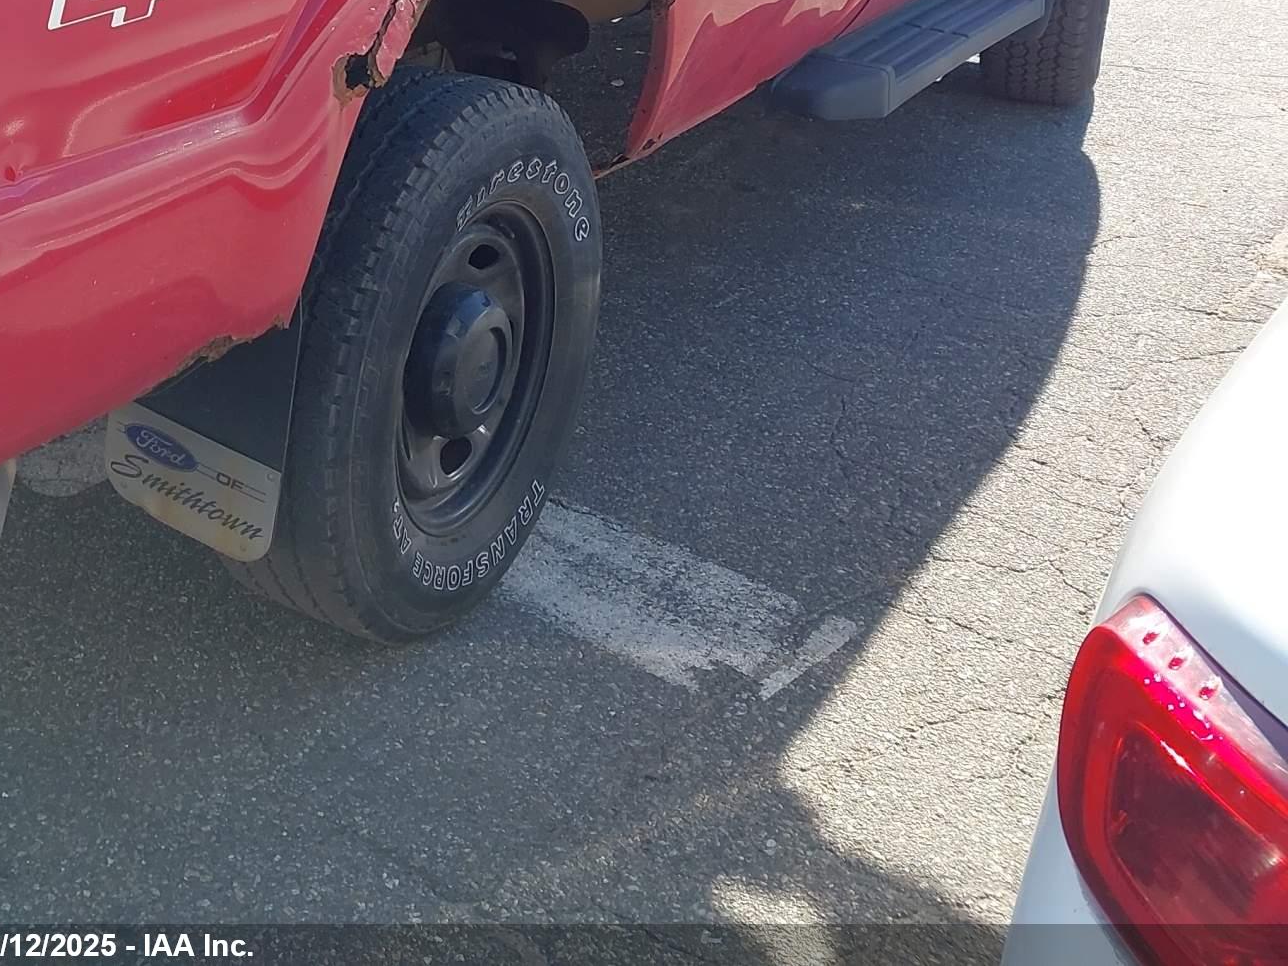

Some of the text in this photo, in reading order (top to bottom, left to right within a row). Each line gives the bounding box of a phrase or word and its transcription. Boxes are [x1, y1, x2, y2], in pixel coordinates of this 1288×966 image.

[456, 156, 590, 242] Firestone
[110, 454, 264, 540] Smithtown
[135, 429, 246, 491] Ford OF
[412, 479, 545, 591] TRANSFORCE
